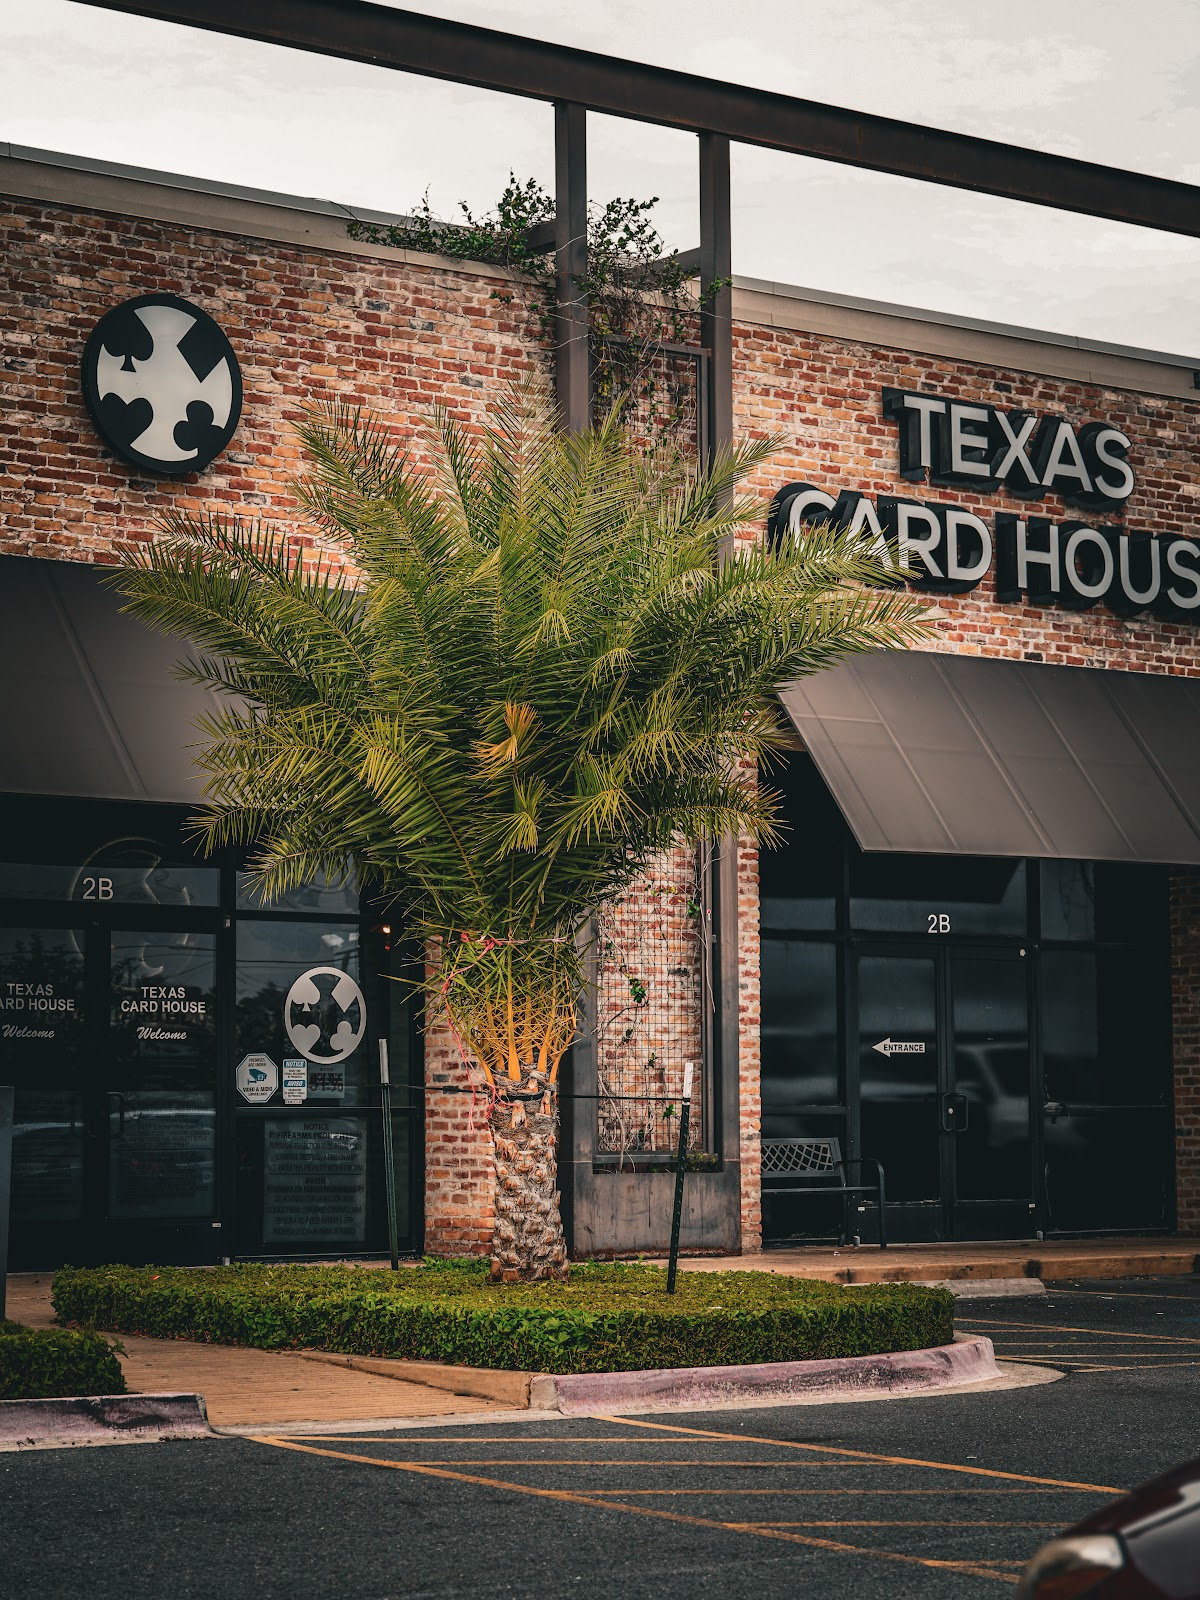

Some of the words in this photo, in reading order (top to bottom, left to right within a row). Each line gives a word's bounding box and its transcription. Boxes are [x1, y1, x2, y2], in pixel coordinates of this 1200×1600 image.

[904, 394, 1134, 500] TEXAS
[790, 489, 992, 581] CARD
[82, 877, 114, 900] 2B
[927, 914, 951, 934] 2B
[6, 983, 54, 996] TEXAS
[140, 986, 186, 999] TEXAS
[28, 998, 75, 1011] HOUSE
[121, 1000, 158, 1013] CARD
[161, 1001, 206, 1014] HOUSE
[1, 1024, 56, 1039] Welcome
[136, 1026, 188, 1040] Welcome
[883, 1044, 924, 1052] ENTRANCE
[303, 1123, 329, 1131] NOTICE
[277, 1131, 312, 1140] FIREARMS
[305, 1176, 327, 1185] AVISO
